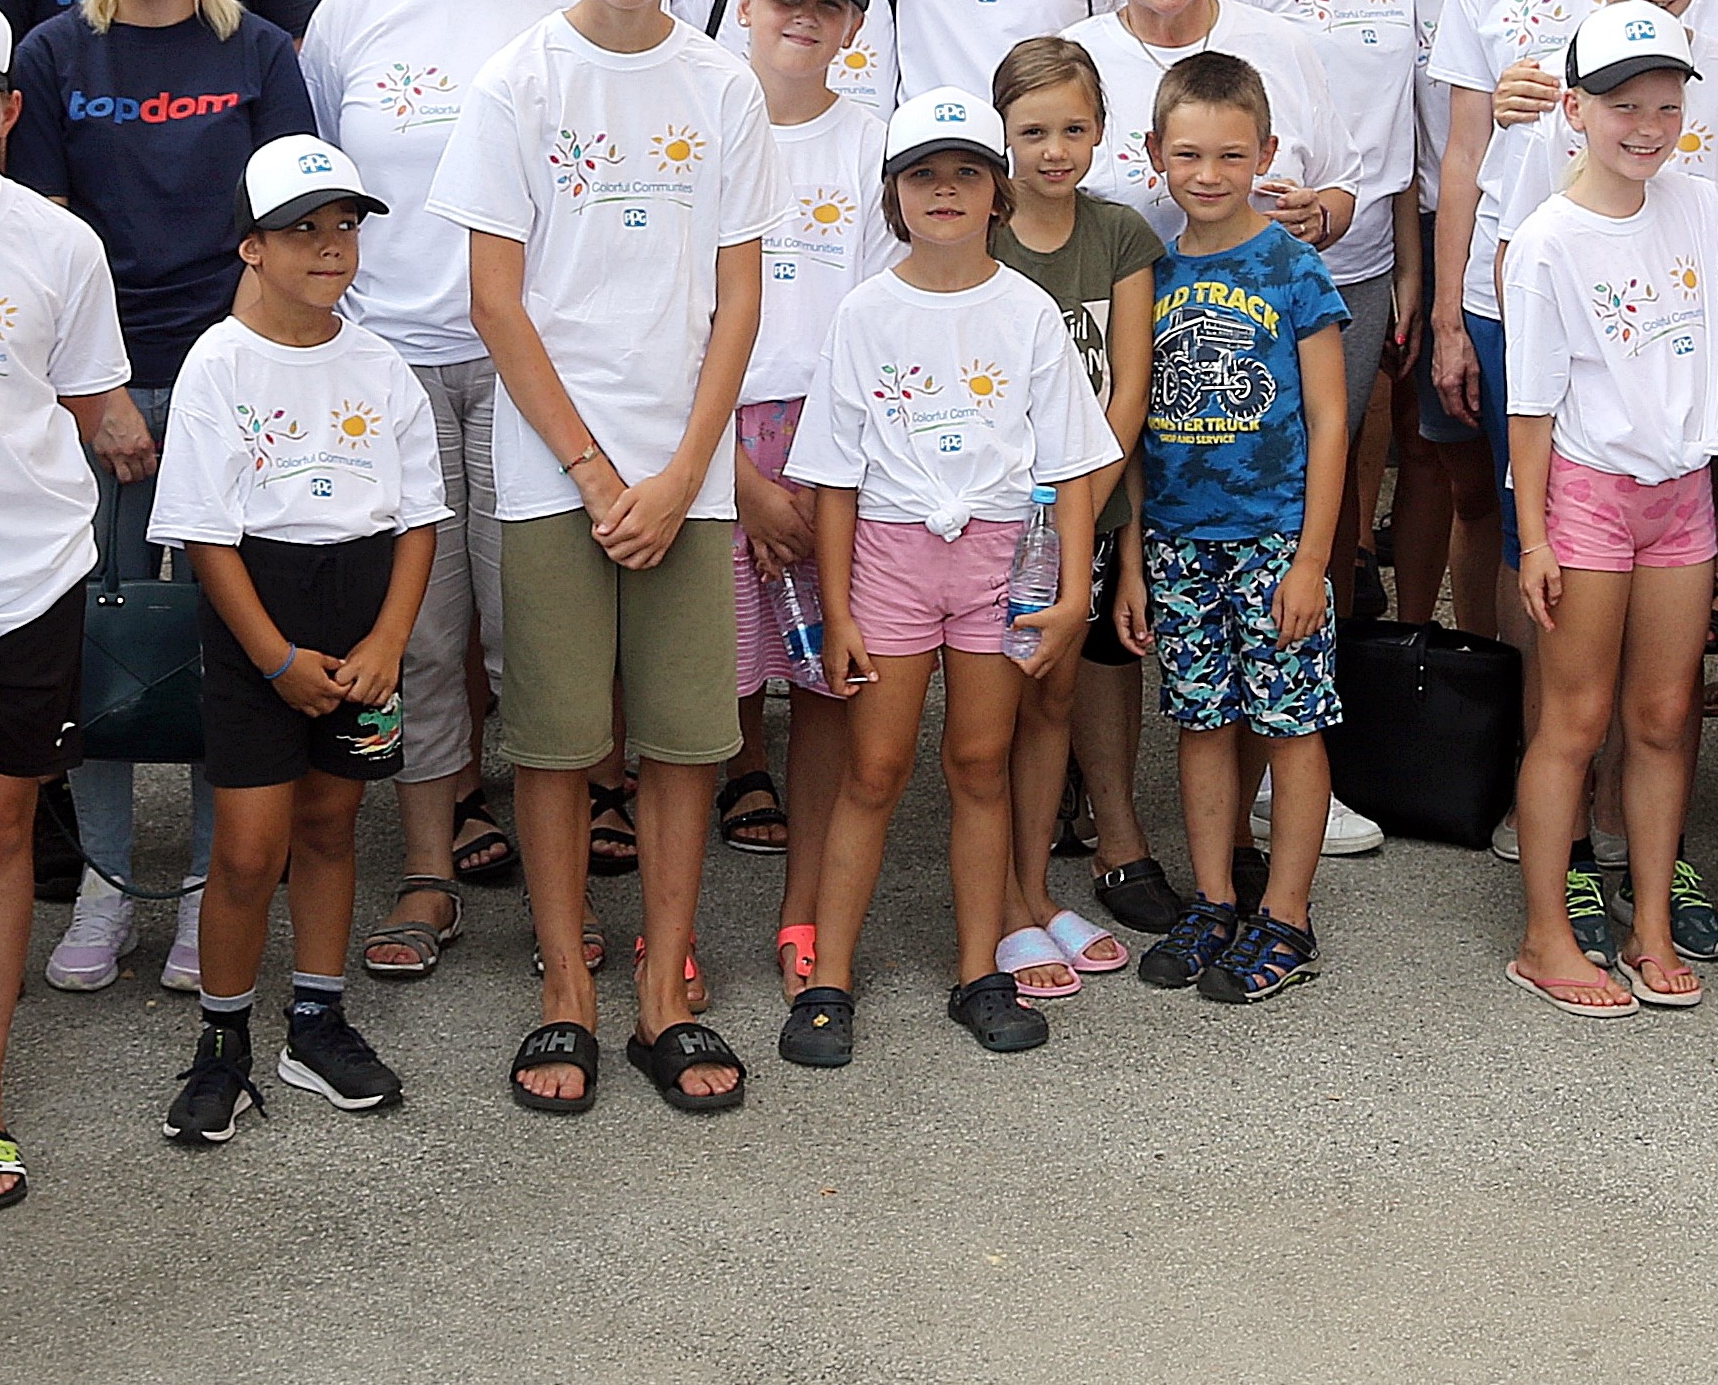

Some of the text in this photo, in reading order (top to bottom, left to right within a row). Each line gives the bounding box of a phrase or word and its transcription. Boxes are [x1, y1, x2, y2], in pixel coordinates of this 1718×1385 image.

[1625, 19, 1656, 41] PPG
[68, 89, 238, 124] topdom
[935, 102, 966, 122] PPG
[298, 153, 333, 174] PPG
[591, 181, 629, 195] Colorful
[624, 209, 647, 227] PPG
[774, 263, 795, 280] PPG
[1193, 281, 1281, 339] TRACK
[1205, 417, 1261, 432] TRUCK
[940, 434, 962, 452] PPG
[1196, 434, 1236, 445] SERVICE
[275, 453, 317, 470] Colorful
[311, 478, 333, 496] PPG
[525, 1031, 576, 1056] HH
[678, 1032, 729, 1055] HH
